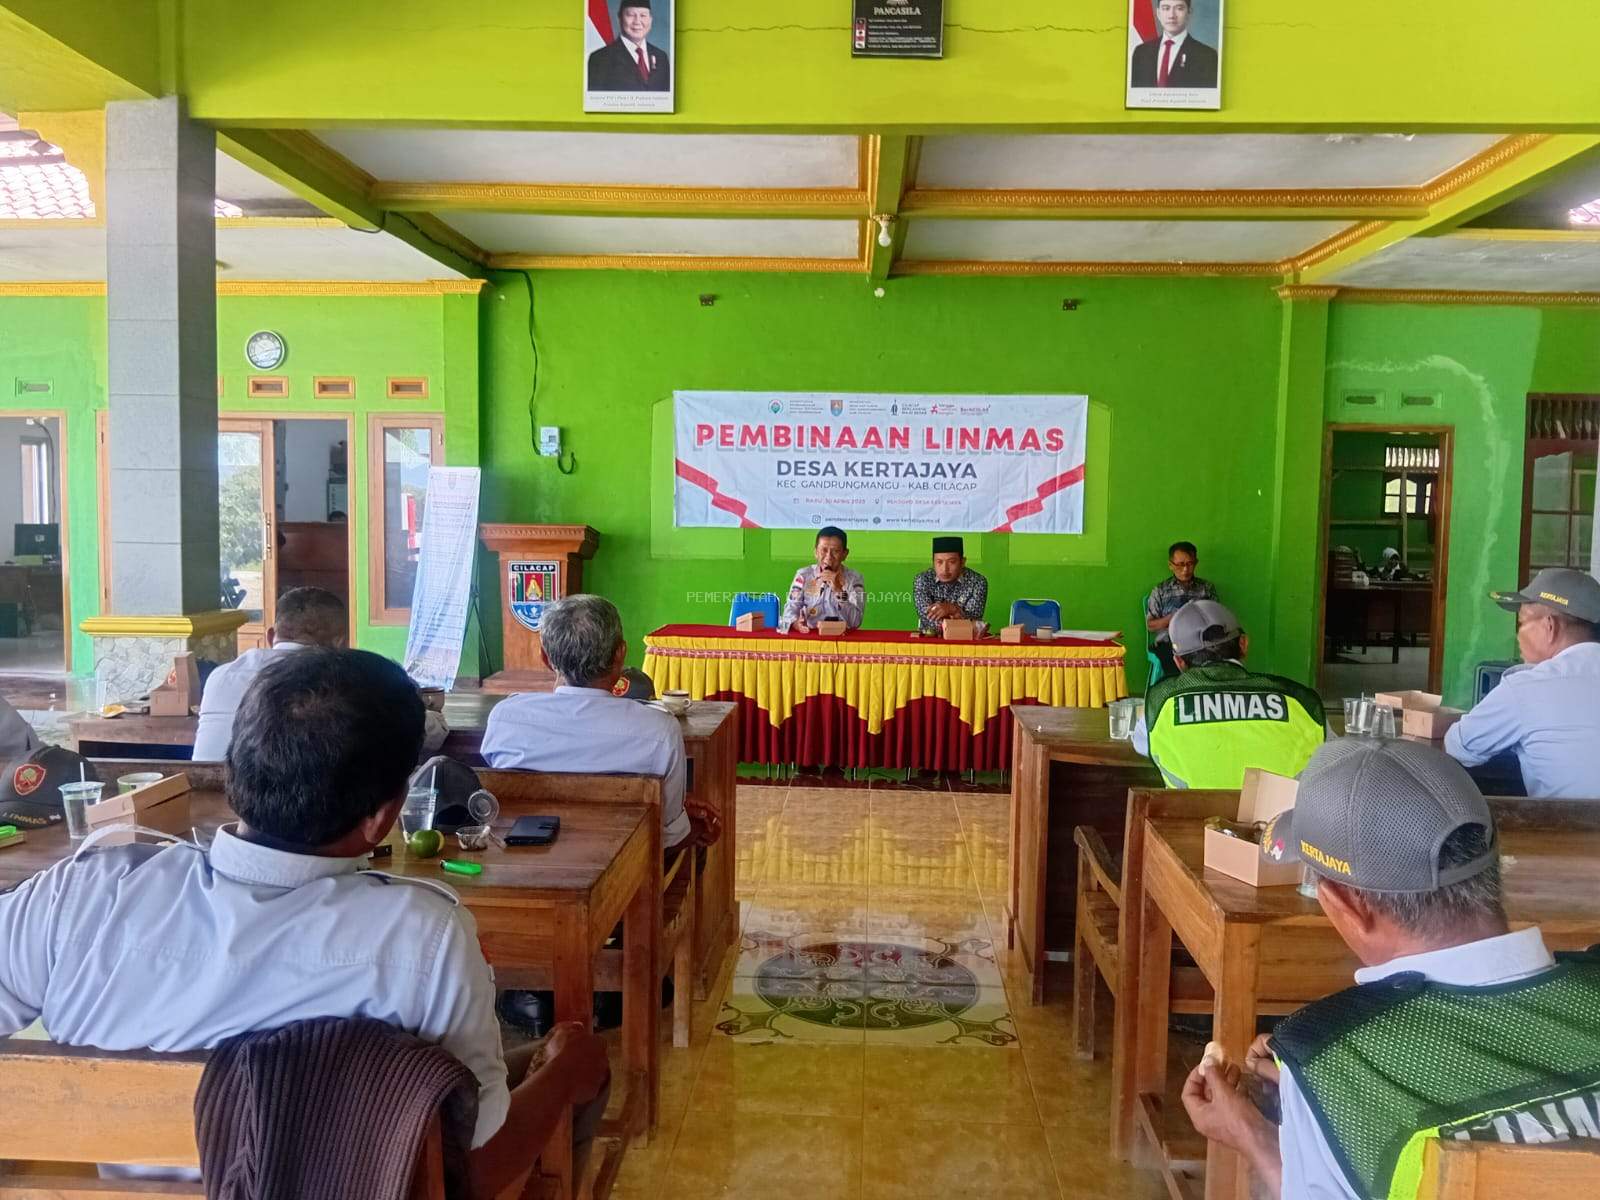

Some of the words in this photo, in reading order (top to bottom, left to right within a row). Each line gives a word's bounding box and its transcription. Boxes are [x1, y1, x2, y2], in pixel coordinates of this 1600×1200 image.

[873, 7, 922, 16] PANCASILA
[694, 423, 911, 452] PEMBINAAN
[923, 426, 1066, 453] LINMAS
[776, 460, 838, 477] DESA
[844, 461, 978, 479] KERTAJAYA
[800, 480, 899, 490] GANDRUNGMANGU
[933, 482, 977, 491] CILACAP
[1178, 692, 1285, 724] LINMAS
[1300, 839, 1352, 876] KERTAJAYA
